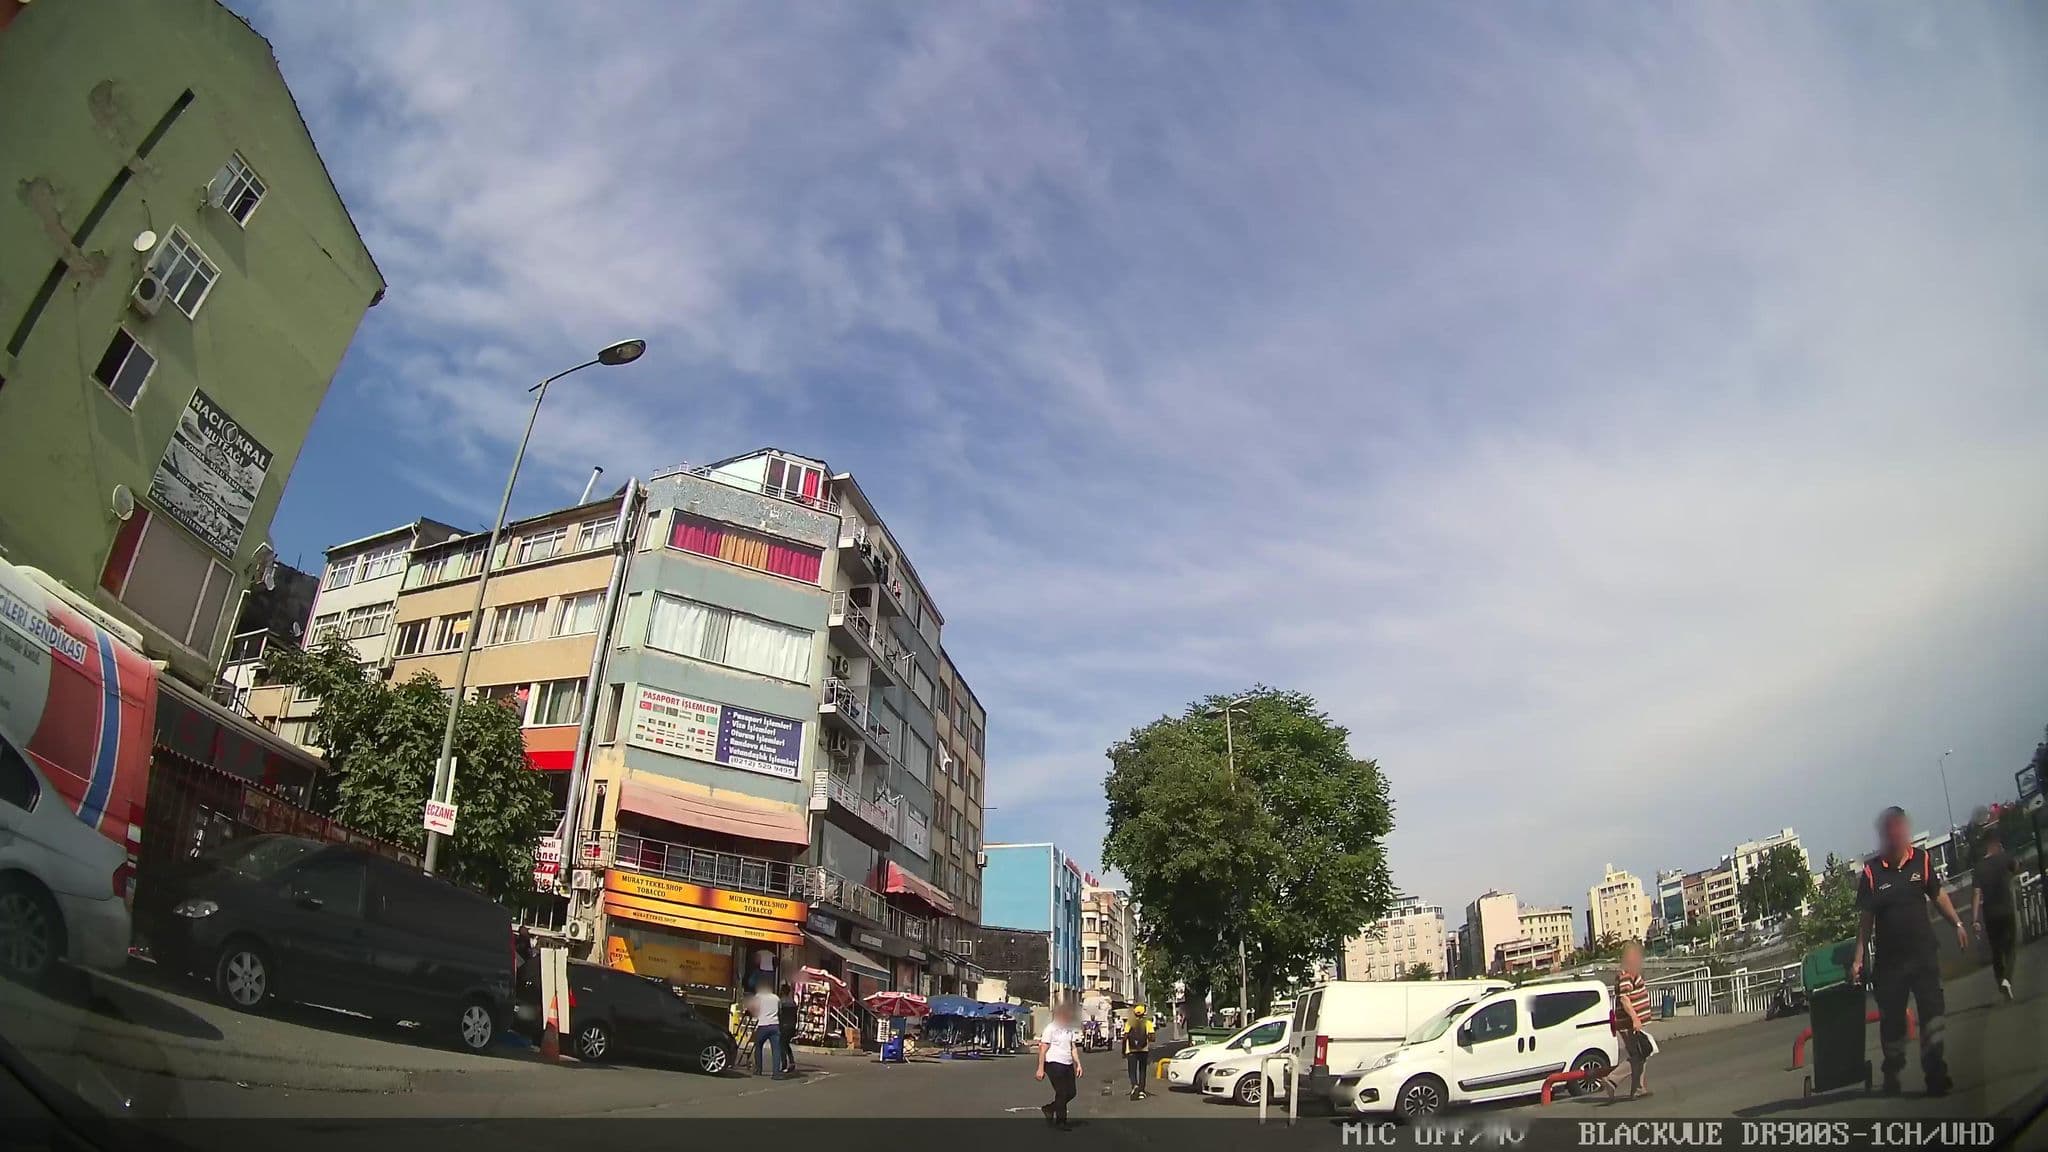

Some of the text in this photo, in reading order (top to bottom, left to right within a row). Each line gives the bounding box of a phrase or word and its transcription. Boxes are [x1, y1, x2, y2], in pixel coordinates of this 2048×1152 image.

[191, 395, 265, 468] HACI KRAL
[204, 426, 244, 465] MUTFAĞI
[29, 614, 85, 663] SENDİKASI
[643, 690, 680, 706] PASAPORT
[733, 711, 792, 731] Pasaport İşlemleri
[747, 720, 776, 736] İşlemleri
[730, 738, 758, 750] Randevu
[731, 729, 785, 747] Oturum İşlemleri
[731, 757, 755, 768] (0212)
[768, 753, 798, 767] İşlemleri
[426, 803, 455, 821] ECZANE
[622, 874, 683, 892] MURAT TEKEL SHOP
[636, 886, 666, 897] TOBACCO
[729, 895, 789, 910] MURAT TEKEL SHOP
[744, 905, 773, 915] TOBACCO
